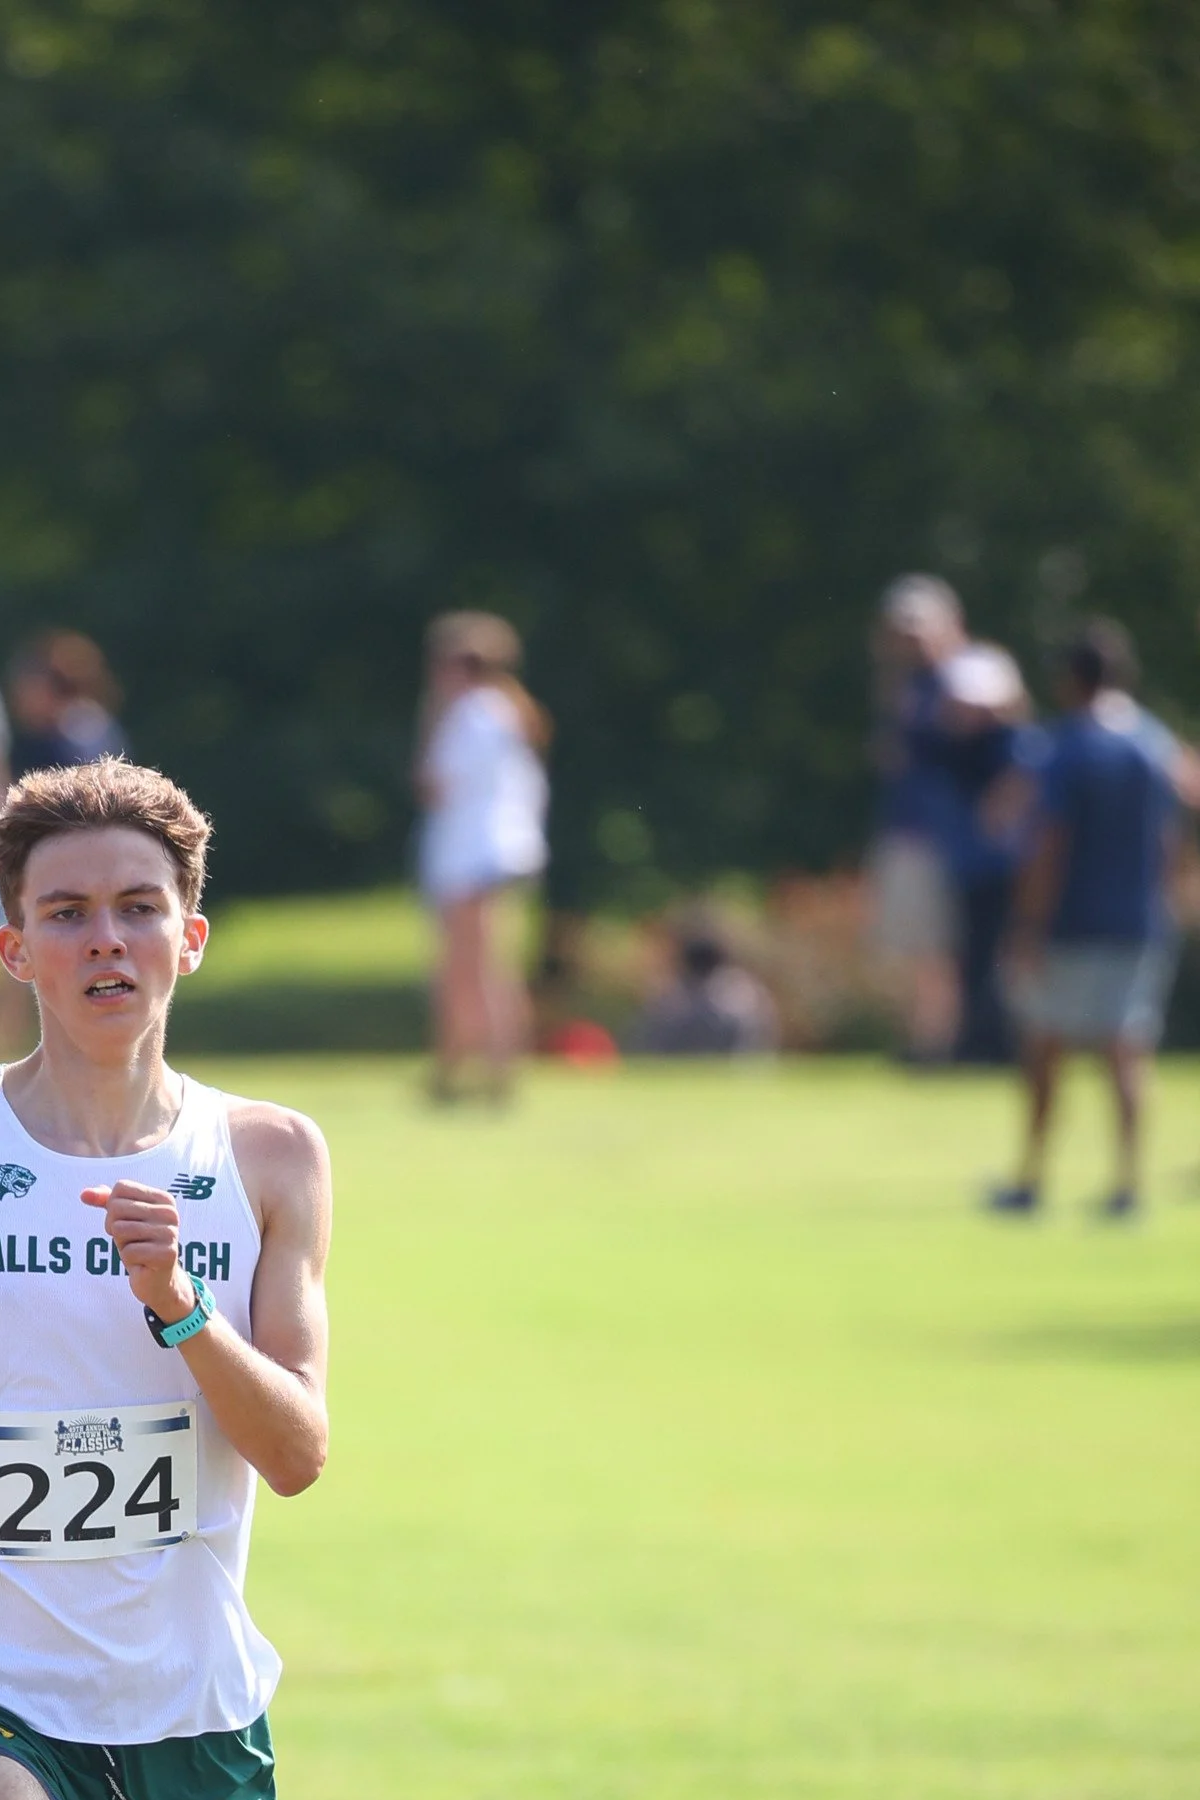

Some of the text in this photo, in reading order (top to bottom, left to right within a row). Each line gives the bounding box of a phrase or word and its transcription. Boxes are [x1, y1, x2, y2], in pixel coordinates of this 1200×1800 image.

[167, 1173, 216, 1200] NB
[86, 1237, 230, 1281] CHCH
[63, 1437, 116, 1452] CLASSIC
